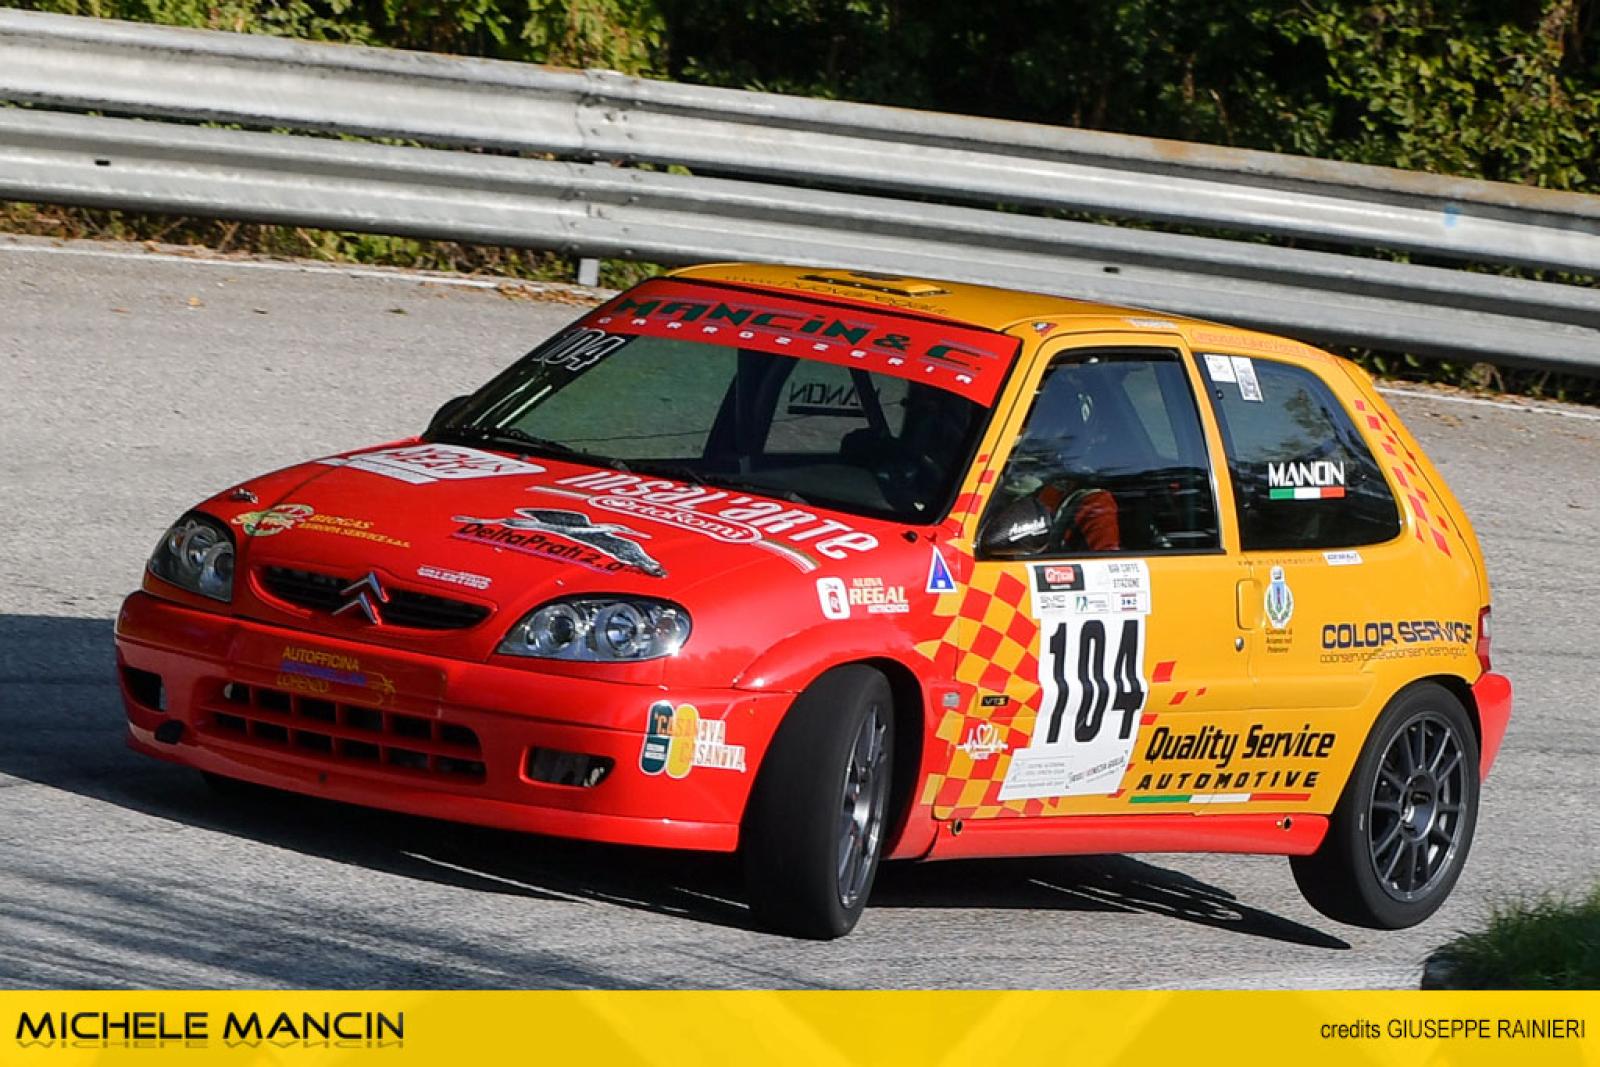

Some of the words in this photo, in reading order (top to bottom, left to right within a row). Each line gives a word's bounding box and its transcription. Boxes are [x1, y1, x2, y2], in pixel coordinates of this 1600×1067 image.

[531, 326, 626, 371] 104
[597, 316, 973, 386] CARROZZERIA
[872, 333, 911, 351] &
[1268, 461, 1345, 488] MANCIN
[848, 585, 909, 606] REGAL
[1322, 622, 1398, 649] COLOR
[1397, 619, 1473, 645] SERVICE
[281, 645, 360, 673] AUTOFFICINA
[1046, 619, 1145, 744] 104
[1145, 725, 1239, 769] Quality
[1242, 723, 1336, 760] Service
[1136, 771, 1320, 791] AUTOMOTIVE
